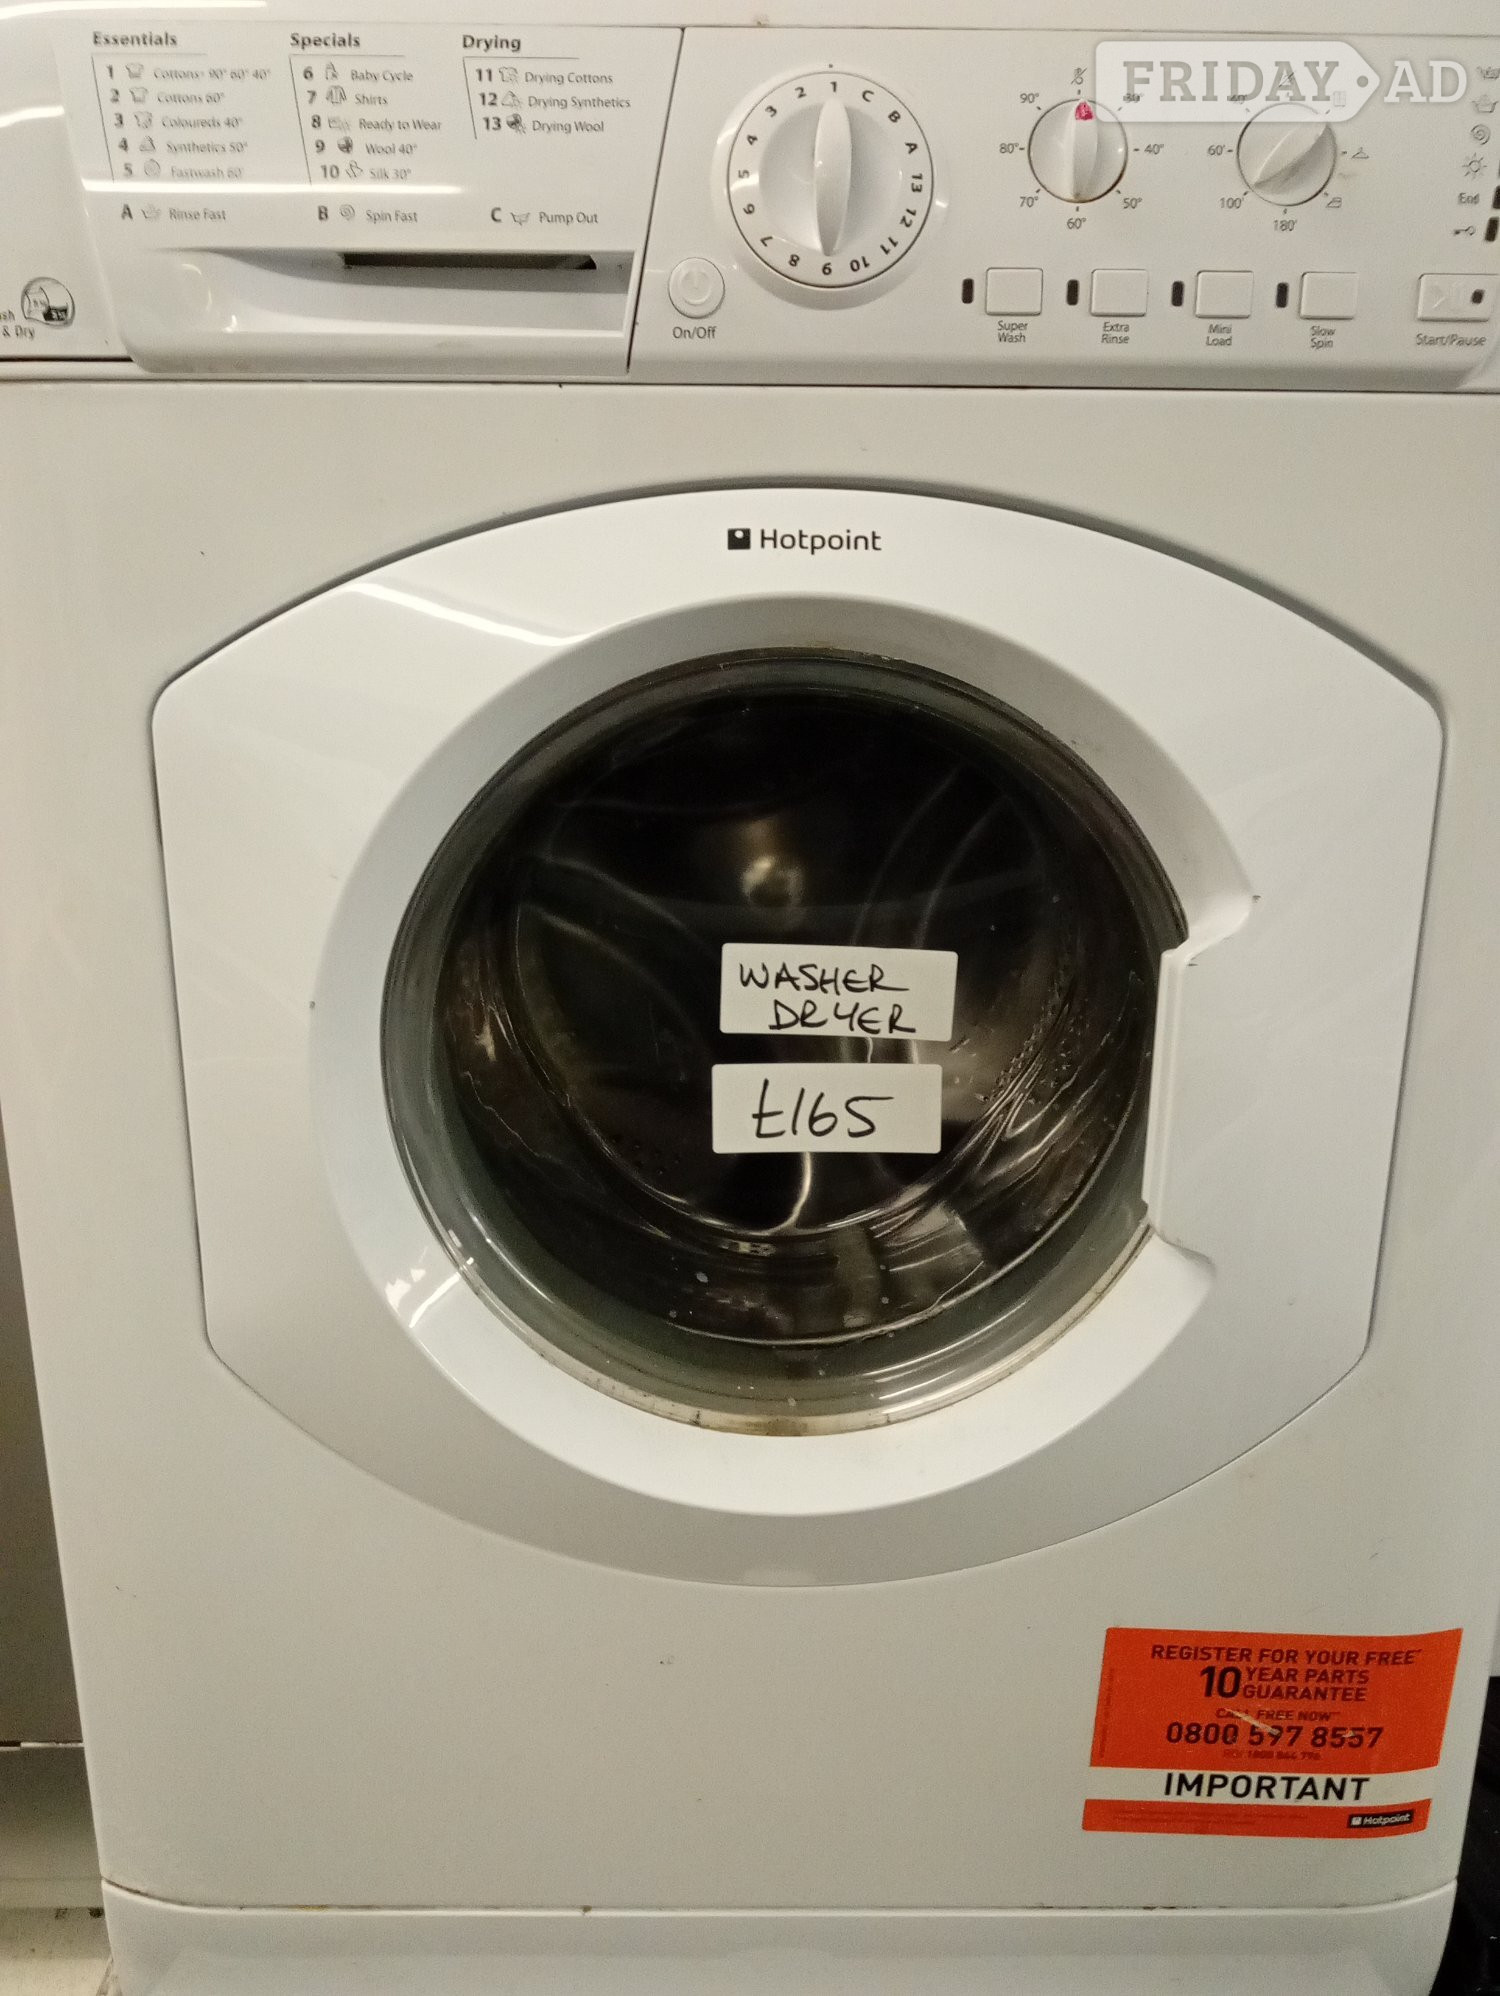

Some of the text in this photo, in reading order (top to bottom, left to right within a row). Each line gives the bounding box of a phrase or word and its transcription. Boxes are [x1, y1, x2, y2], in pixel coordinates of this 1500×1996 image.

[93, 30, 177, 47] Essentials
[290, 31, 361, 50] Specials
[462, 33, 522, 52] Drying
[106, 64, 115, 79] 1
[303, 66, 314, 80] 6
[351, 69, 414, 82] Baby Cycle
[475, 68, 493, 82] 11
[524, 71, 613, 86] Drying Cottons
[794, 86, 808, 99] 2
[829, 81, 838, 93] 1
[110, 88, 120, 103] 2
[157, 91, 203, 103] Cottons
[307, 90, 317, 104] 7
[355, 93, 388, 105] Shirts
[479, 92, 498, 106] 12
[528, 95, 631, 110] Drying Synthetics
[861, 89, 874, 102] C
[765, 105, 778, 118] 3
[888, 110, 901, 123] B
[114, 112, 124, 128] 3
[161, 116, 221, 128] Coloureds
[311, 115, 321, 128] 8
[358, 118, 442, 131] Ready to Wear
[483, 117, 501, 131] 13
[532, 120, 604, 134] Drying Wool
[118, 138, 129, 152] 4
[315, 140, 326, 154] 9
[746, 134, 758, 146] 4
[905, 140, 918, 154] A
[166, 141, 226, 154] Synthetics
[365, 143, 396, 155] Wool
[124, 162, 133, 177] 5
[171, 165, 224, 178] Fastwash
[320, 164, 340, 178] 10
[370, 168, 390, 180] Silk
[738, 169, 751, 180] 5
[911, 173, 923, 194] 13
[1458, 193, 1480, 205] End
[121, 203, 134, 220] A
[169, 208, 227, 221] Rinse Fast
[317, 205, 329, 221] B
[490, 207, 502, 223] C
[743, 203, 756, 215] 6
[365, 209, 418, 225] Spin Fast
[539, 211, 598, 226] Pump Out
[900, 208, 917, 228] 12
[760, 235, 774, 247] 7
[879, 237, 899, 255] 11
[788, 253, 801, 268] 8
[850, 255, 871, 273] 10
[14, 325, 35, 341] Dry
[672, 326, 717, 340] On/Off
[997, 320, 1028, 333] Super
[1102, 321, 1130, 333] Extra
[1208, 323, 1232, 334] Mini
[1310, 325, 1336, 337] Slow
[998, 332, 1026, 343] Wash
[1101, 333, 1130, 345] Rinse
[1206, 335, 1232, 347] Load
[1310, 338, 1334, 350] Spin
[1416, 333, 1487, 348] Start/Pause
[760, 528, 882, 556] Hotpoint
[739, 961, 910, 996] WASHER
[768, 999, 916, 1034] DRYER
[752, 1078, 895, 1139] £165
[1151, 1644, 1252, 1664] REGISTER
[1259, 1647, 1298, 1665] FOR
[1305, 1649, 1358, 1666] YOUR
[1200, 1666, 1241, 1699] 10
[1245, 1666, 1370, 1685] YEAR PARTS
[1243, 1685, 1367, 1702] GUARANTEE
[1257, 1709, 1295, 1721] FREE
[1166, 1722, 1239, 1745] 0800
[1164, 1772, 1370, 1802] IMPORTANT
[1363, 1813, 1411, 1826] Hotpoint
